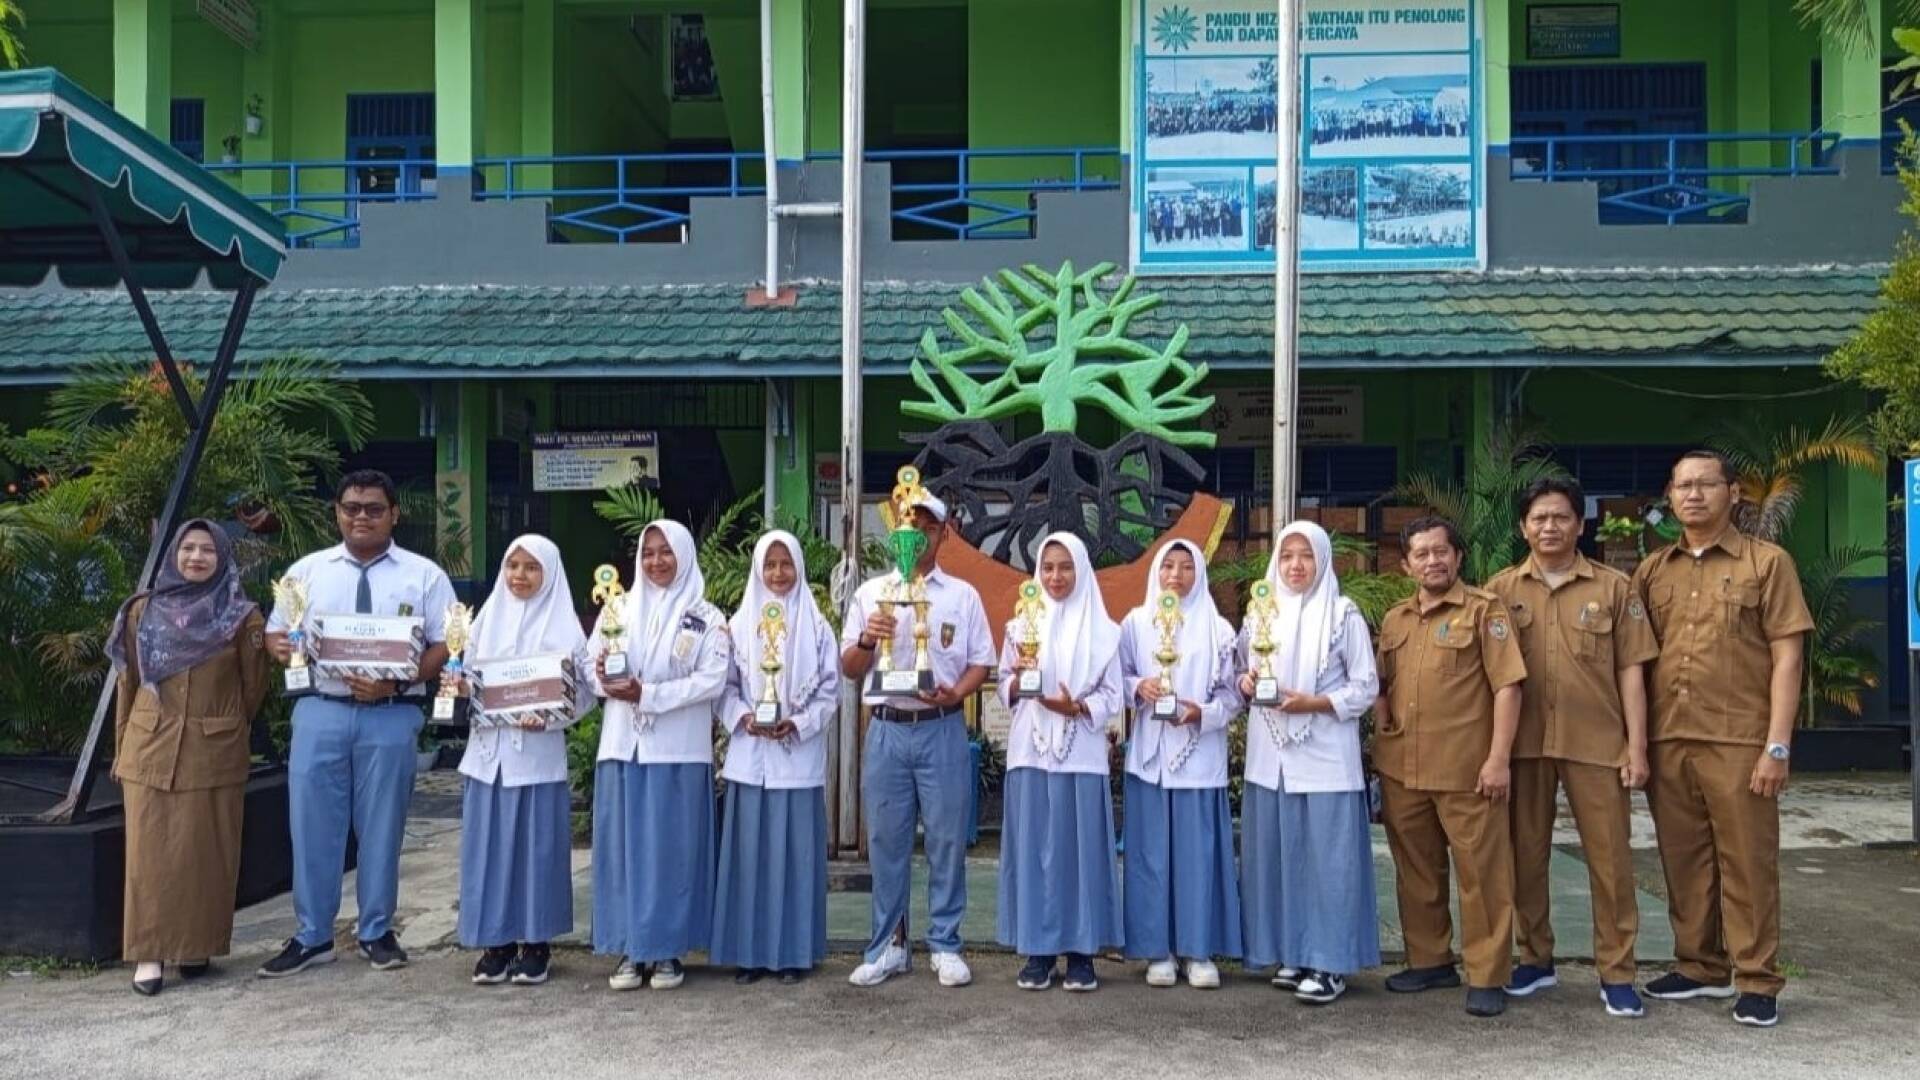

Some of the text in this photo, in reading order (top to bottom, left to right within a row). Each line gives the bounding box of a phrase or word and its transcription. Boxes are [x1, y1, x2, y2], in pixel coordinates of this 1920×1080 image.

[1205, 9, 1466, 27] PANDU HIZ WATHAN ITU PENOLONG
[1205, 28, 1233, 42] DAN
